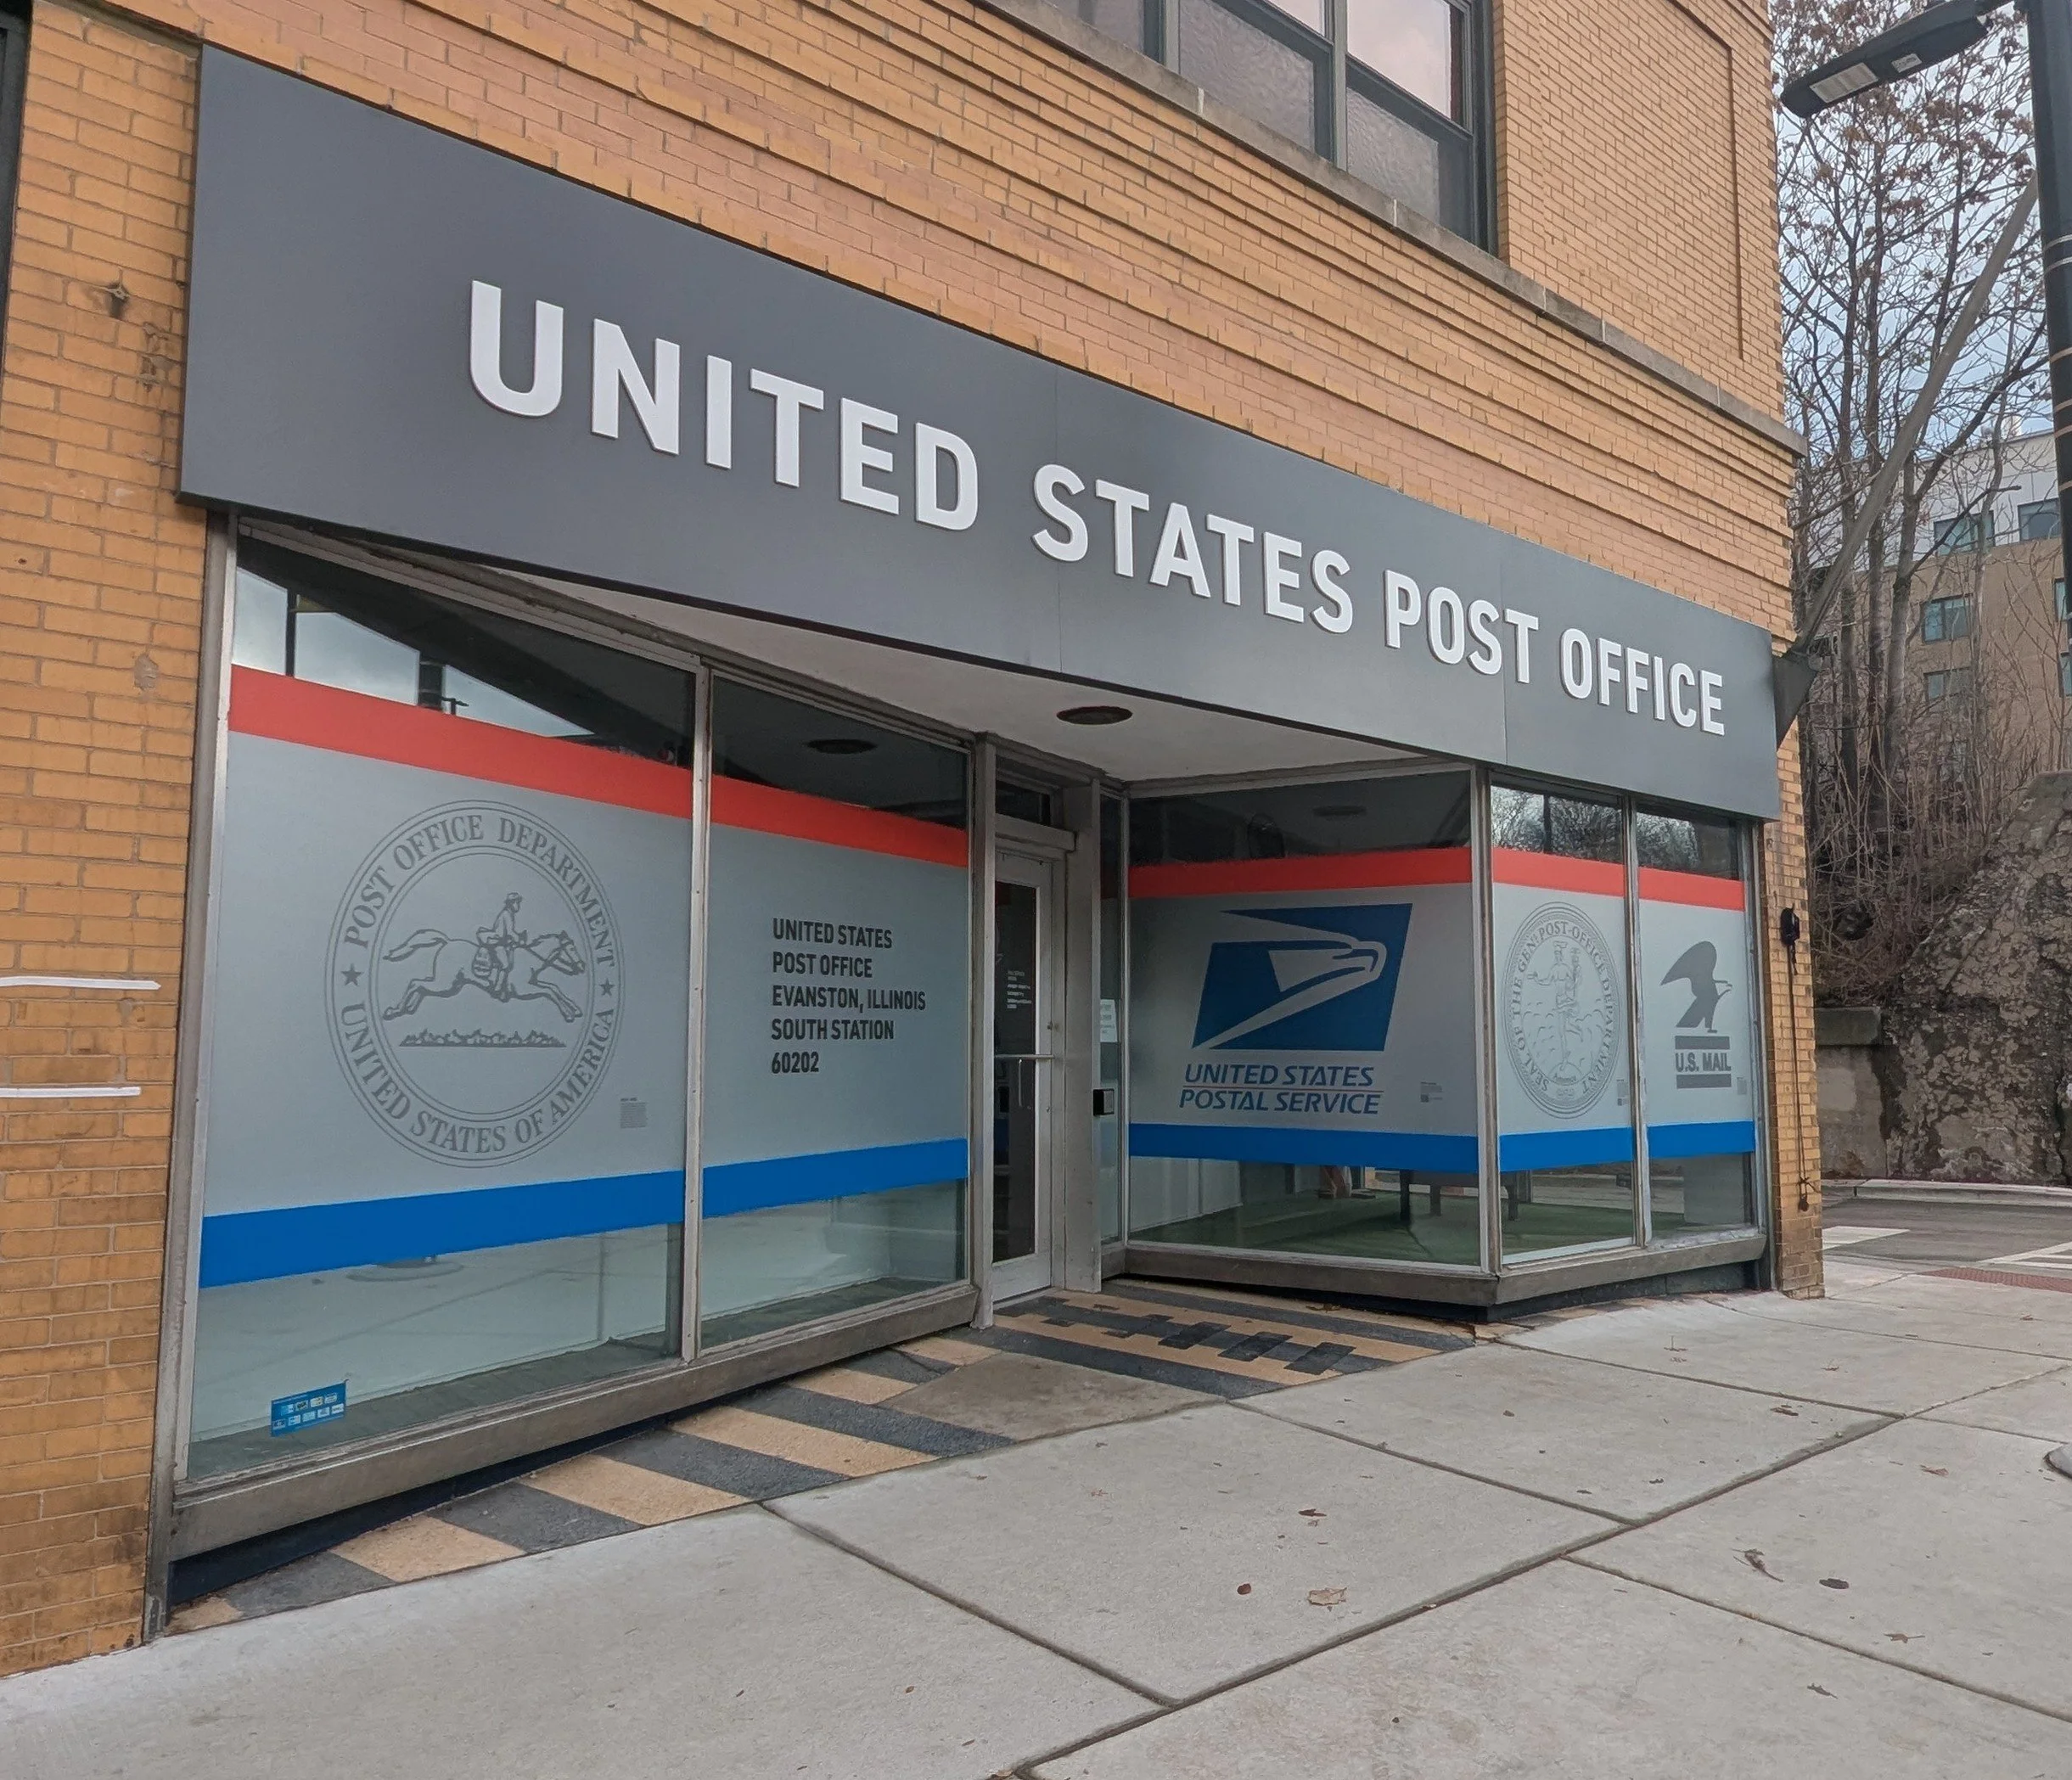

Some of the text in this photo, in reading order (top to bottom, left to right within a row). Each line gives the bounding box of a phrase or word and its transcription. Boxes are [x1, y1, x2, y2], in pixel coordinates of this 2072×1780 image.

[469, 280, 1726, 737] UNITED STATES POST OFFICE
[344, 815, 615, 969] POST OFFICE DEPARTMENT
[772, 918, 893, 949] UNITED STATES
[772, 952, 873, 978] POST OFFICE
[772, 985, 927, 1014] EVANSTON, ILLINOIS
[771, 1019, 895, 1041] SOUTH STATION
[772, 1052, 820, 1074] 60202
[1185, 1063, 1375, 1087] UNITED STATES
[1522, 1053, 1550, 1092] SEAL
[1675, 1052, 1732, 1072] U.S. MAIL
[341, 1002, 615, 1154] UNITED STATES OF AMERICA
[1179, 1089, 1382, 1115] POSTAL SERVICE
